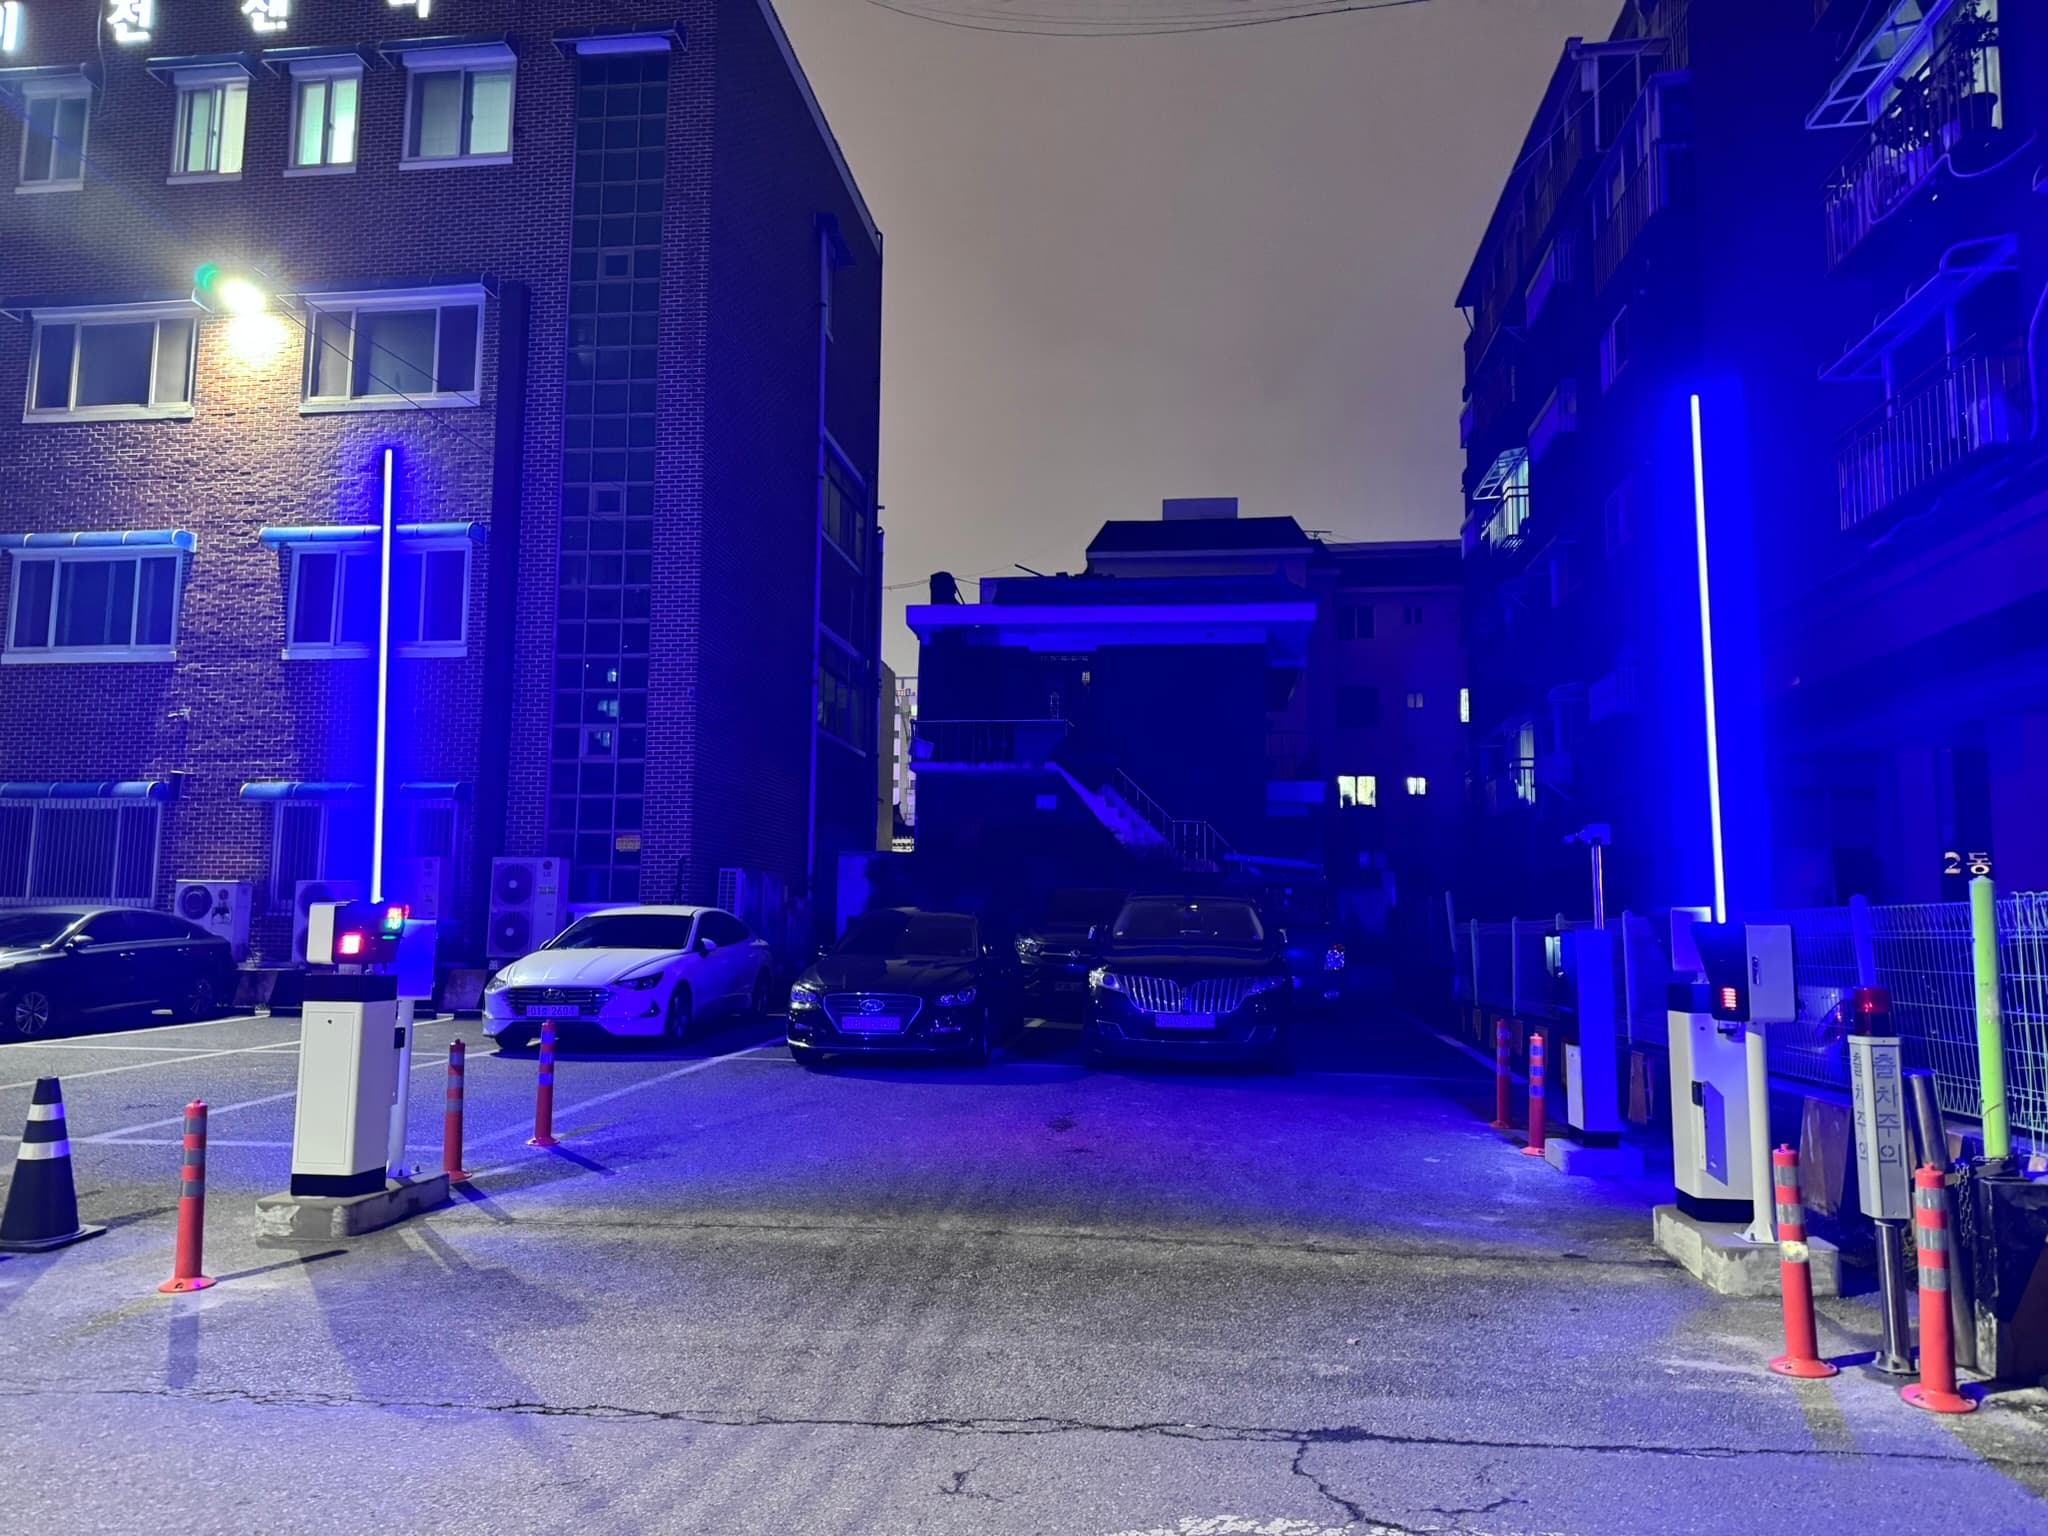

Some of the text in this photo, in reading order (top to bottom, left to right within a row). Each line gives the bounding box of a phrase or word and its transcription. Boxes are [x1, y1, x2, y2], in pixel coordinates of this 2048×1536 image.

[1943, 851, 1993, 875] 2동
[1852, 1052, 1867, 1160] 출차주의
[1872, 1053, 1903, 1168] 출차주의
